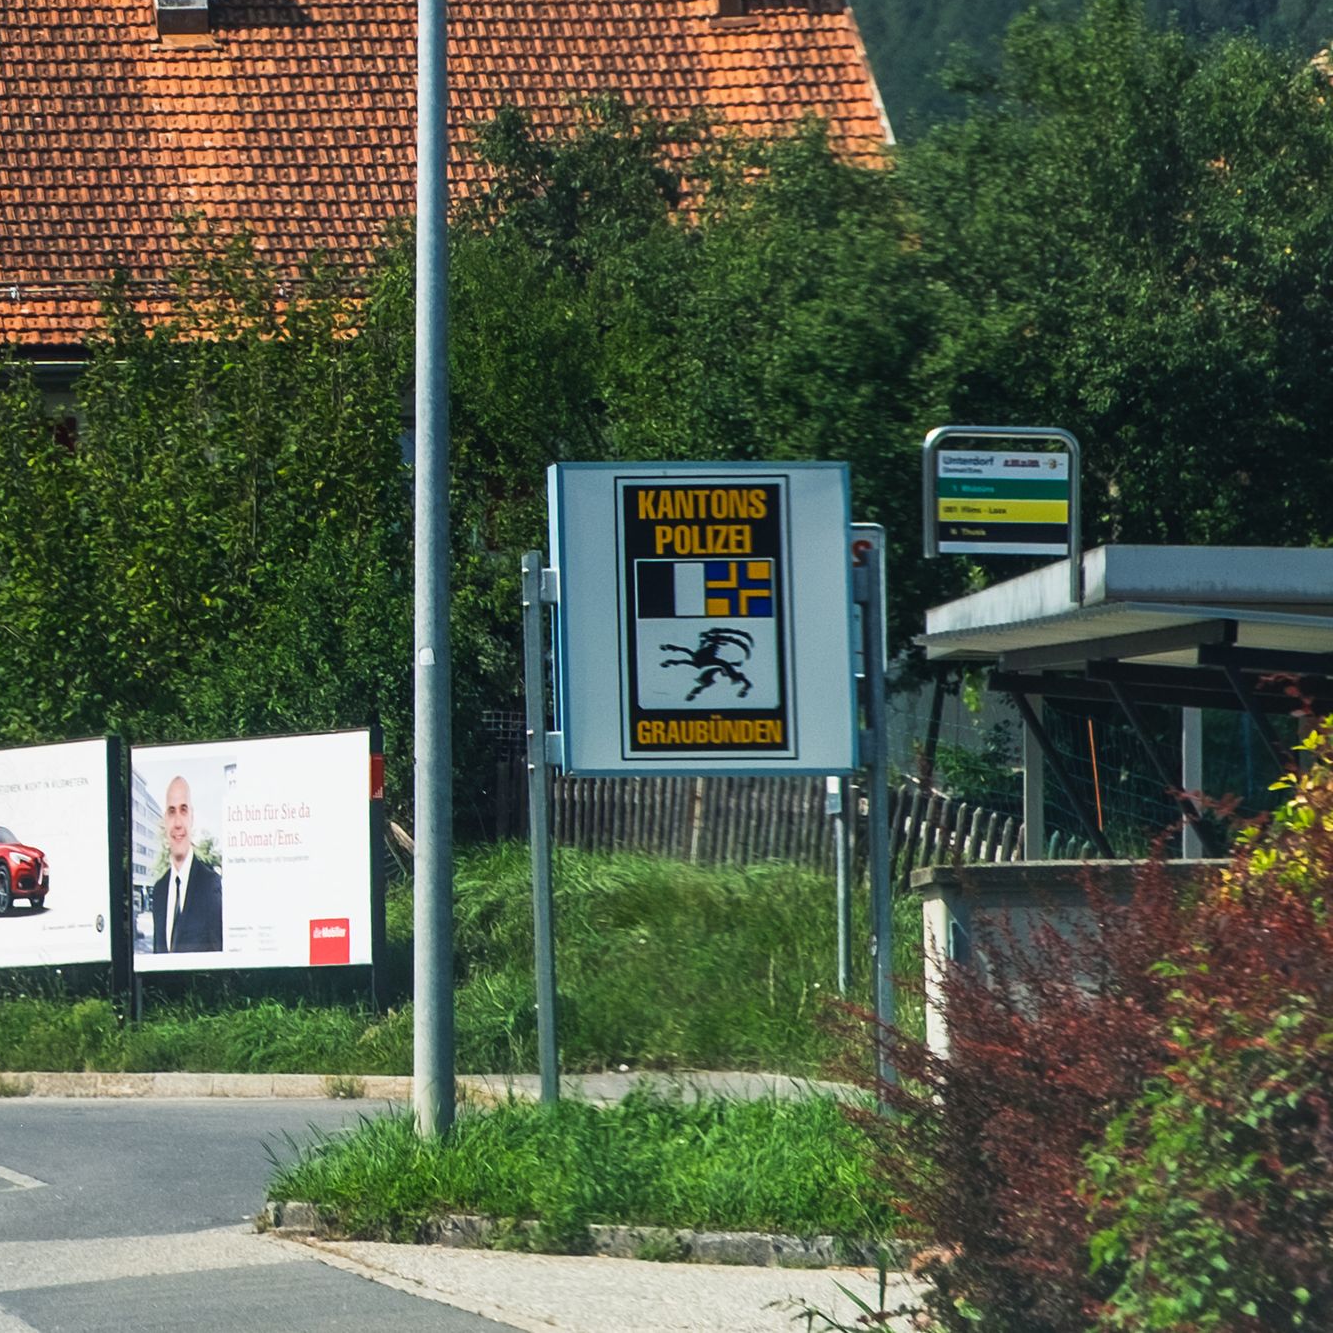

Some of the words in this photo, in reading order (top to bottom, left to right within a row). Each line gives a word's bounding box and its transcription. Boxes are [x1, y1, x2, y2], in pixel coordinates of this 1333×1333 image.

[638, 489, 767, 520] KANTONS
[655, 525, 753, 555] POLIZEI
[637, 714, 782, 744] GRAUBÜNDEN
[228, 805, 243, 822] Ich
[245, 804, 261, 821] bin
[263, 803, 279, 820] für
[281, 802, 296, 820] Sie
[299, 801, 310, 818] da
[228, 832, 237, 847] in
